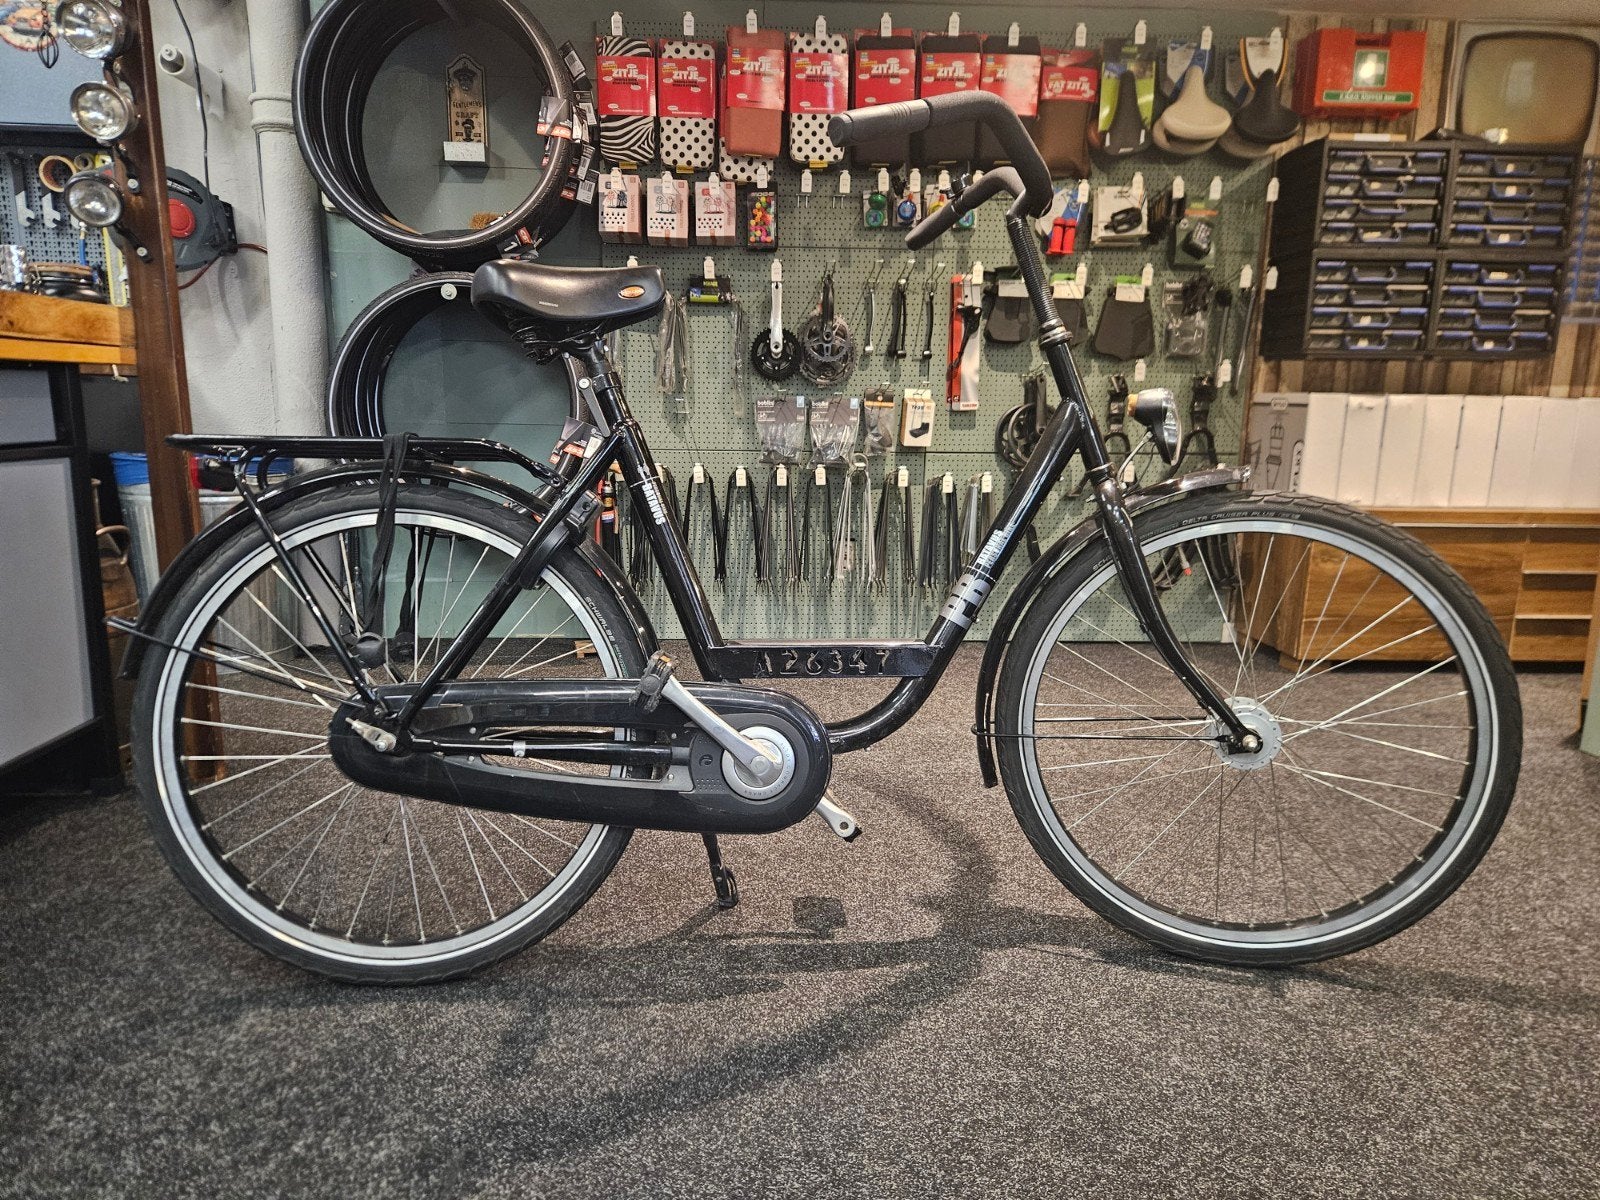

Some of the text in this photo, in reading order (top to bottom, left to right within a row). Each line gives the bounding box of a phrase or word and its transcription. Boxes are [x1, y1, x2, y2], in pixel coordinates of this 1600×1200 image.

[612, 68, 639, 78] ZITJE
[805, 65, 833, 75] ZITJE
[871, 63, 900, 74] ZITJE
[936, 66, 965, 77] ZITJE
[672, 70, 699, 80] ZITJE
[642, 482, 666, 525] BATAVUS
[1182, 515, 1208, 526] DELTA
[1210, 511, 1249, 520] CRUISER
[976, 529, 1003, 566] BATAVUS
[585, 596, 616, 642] SCHWALBE
